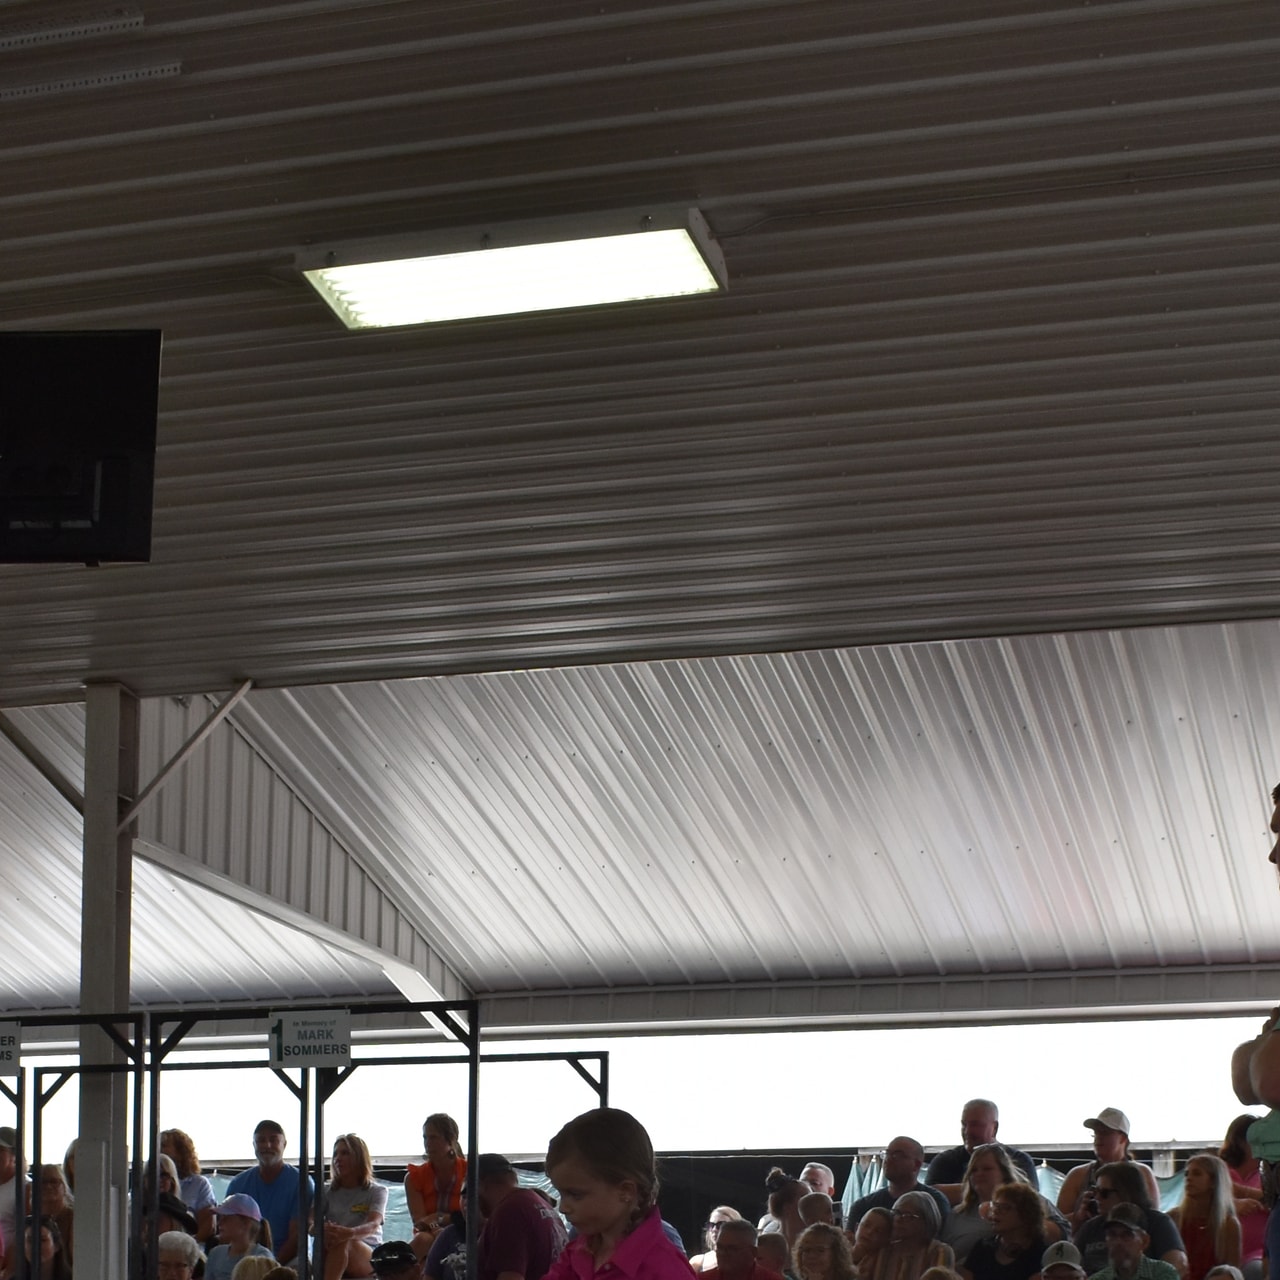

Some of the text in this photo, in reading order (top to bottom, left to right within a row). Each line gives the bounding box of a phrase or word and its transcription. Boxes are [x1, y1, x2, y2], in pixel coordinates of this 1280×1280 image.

[272, 1019, 283, 1061] 1
[298, 1029, 334, 1040] MARK
[284, 1044, 348, 1056] SOMMERS
